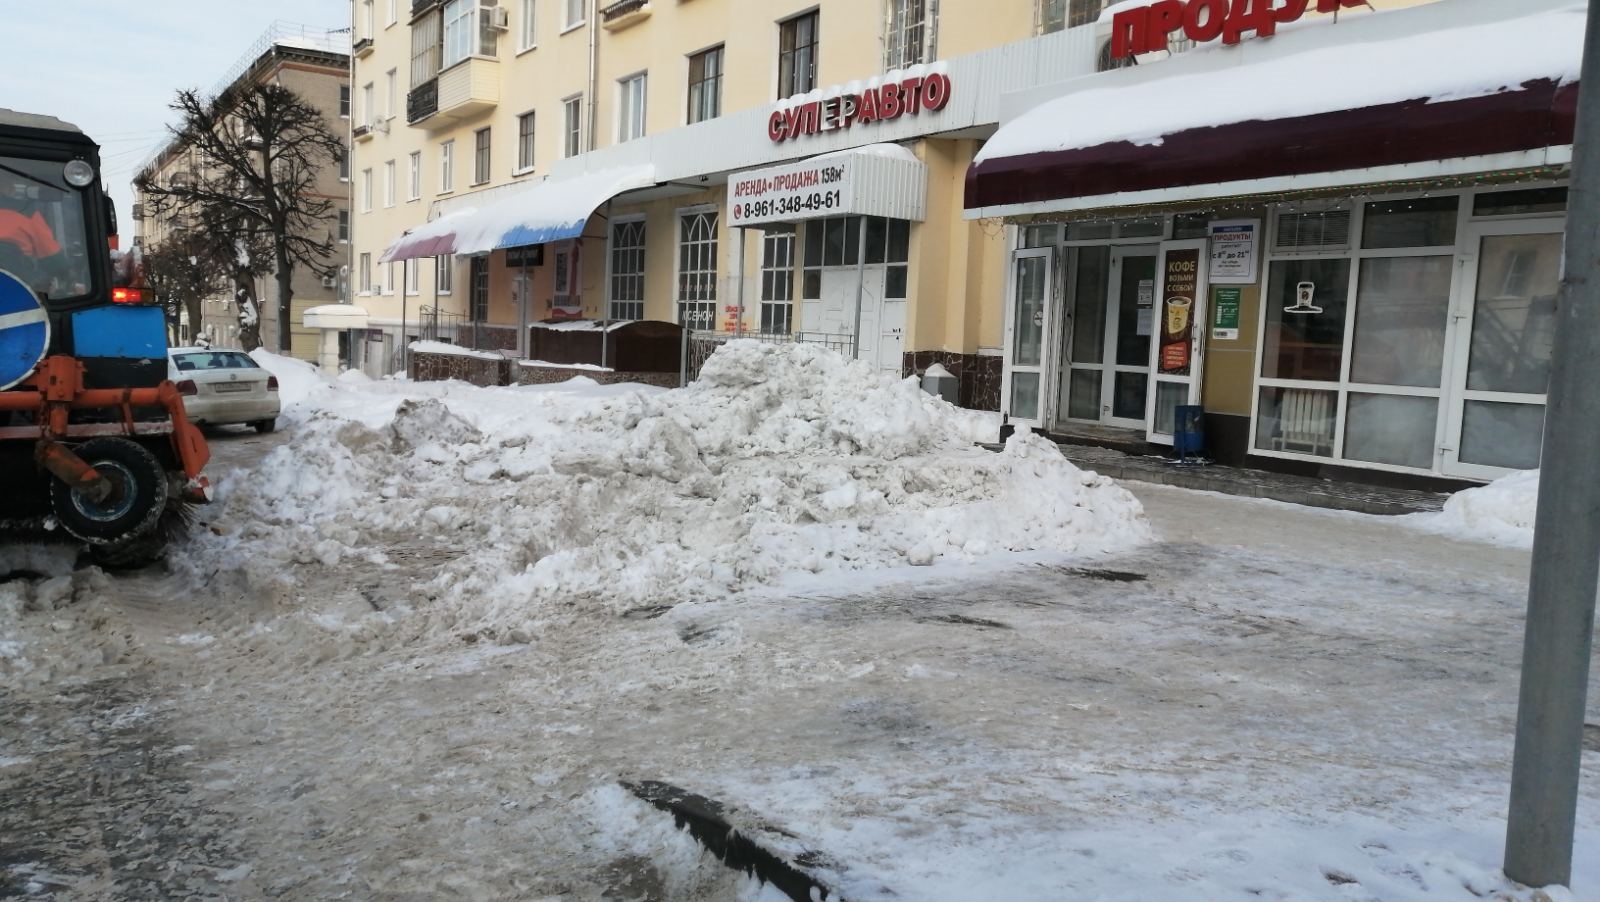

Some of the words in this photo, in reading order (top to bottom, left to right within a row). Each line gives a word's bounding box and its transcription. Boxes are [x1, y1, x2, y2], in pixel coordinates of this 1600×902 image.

[1110, 0, 1367, 59] ПРОДУ
[768, 72, 951, 142] СУПЕРАВТО
[744, 189, 840, 218] 8-961-348-49-61
[1214, 232, 1251, 241] ПРОДУКТЫ
[1169, 261, 1196, 272] КОФЕ
